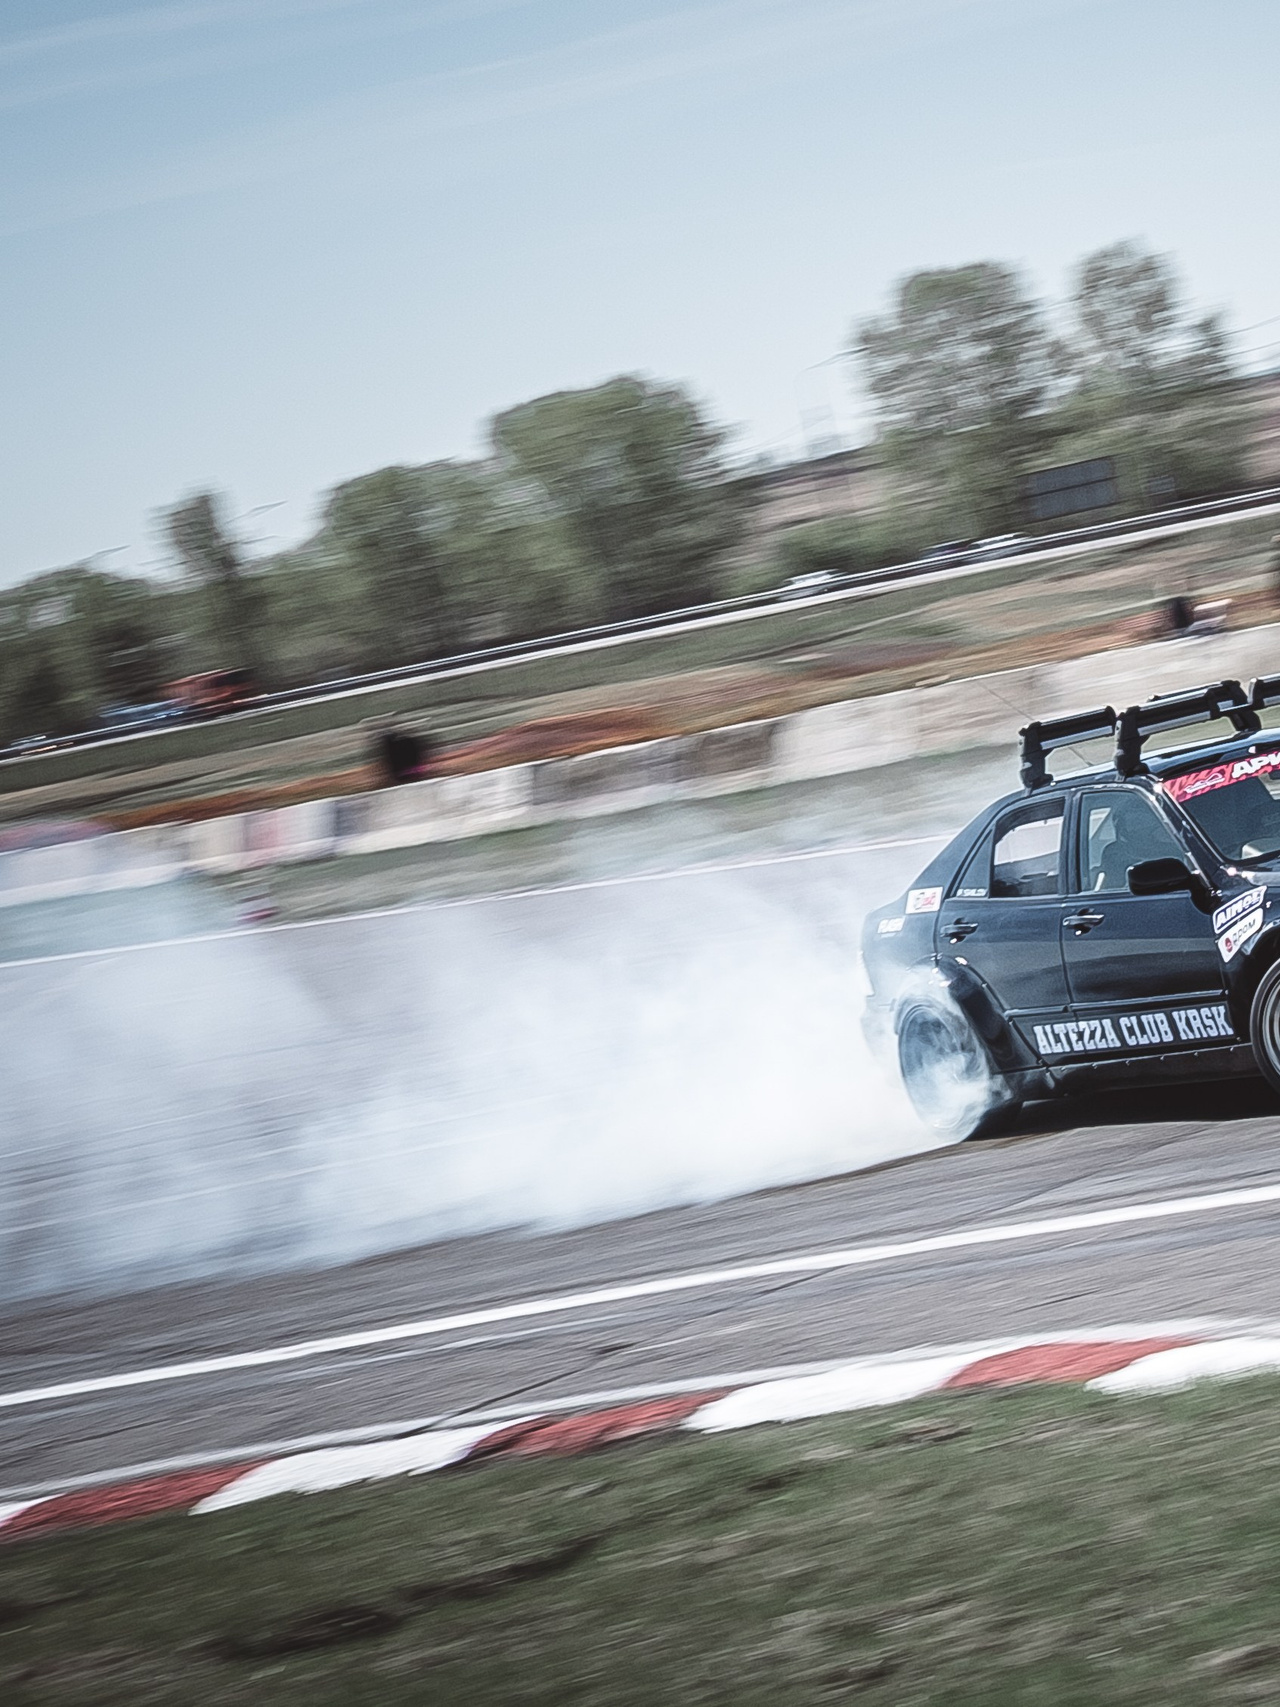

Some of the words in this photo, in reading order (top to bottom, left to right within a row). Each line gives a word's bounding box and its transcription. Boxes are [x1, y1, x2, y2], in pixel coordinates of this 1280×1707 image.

[1033, 1018, 1121, 1054] ALTEZZA
[1119, 1012, 1174, 1046] CLUB
[1171, 1005, 1234, 1041] KRSK
